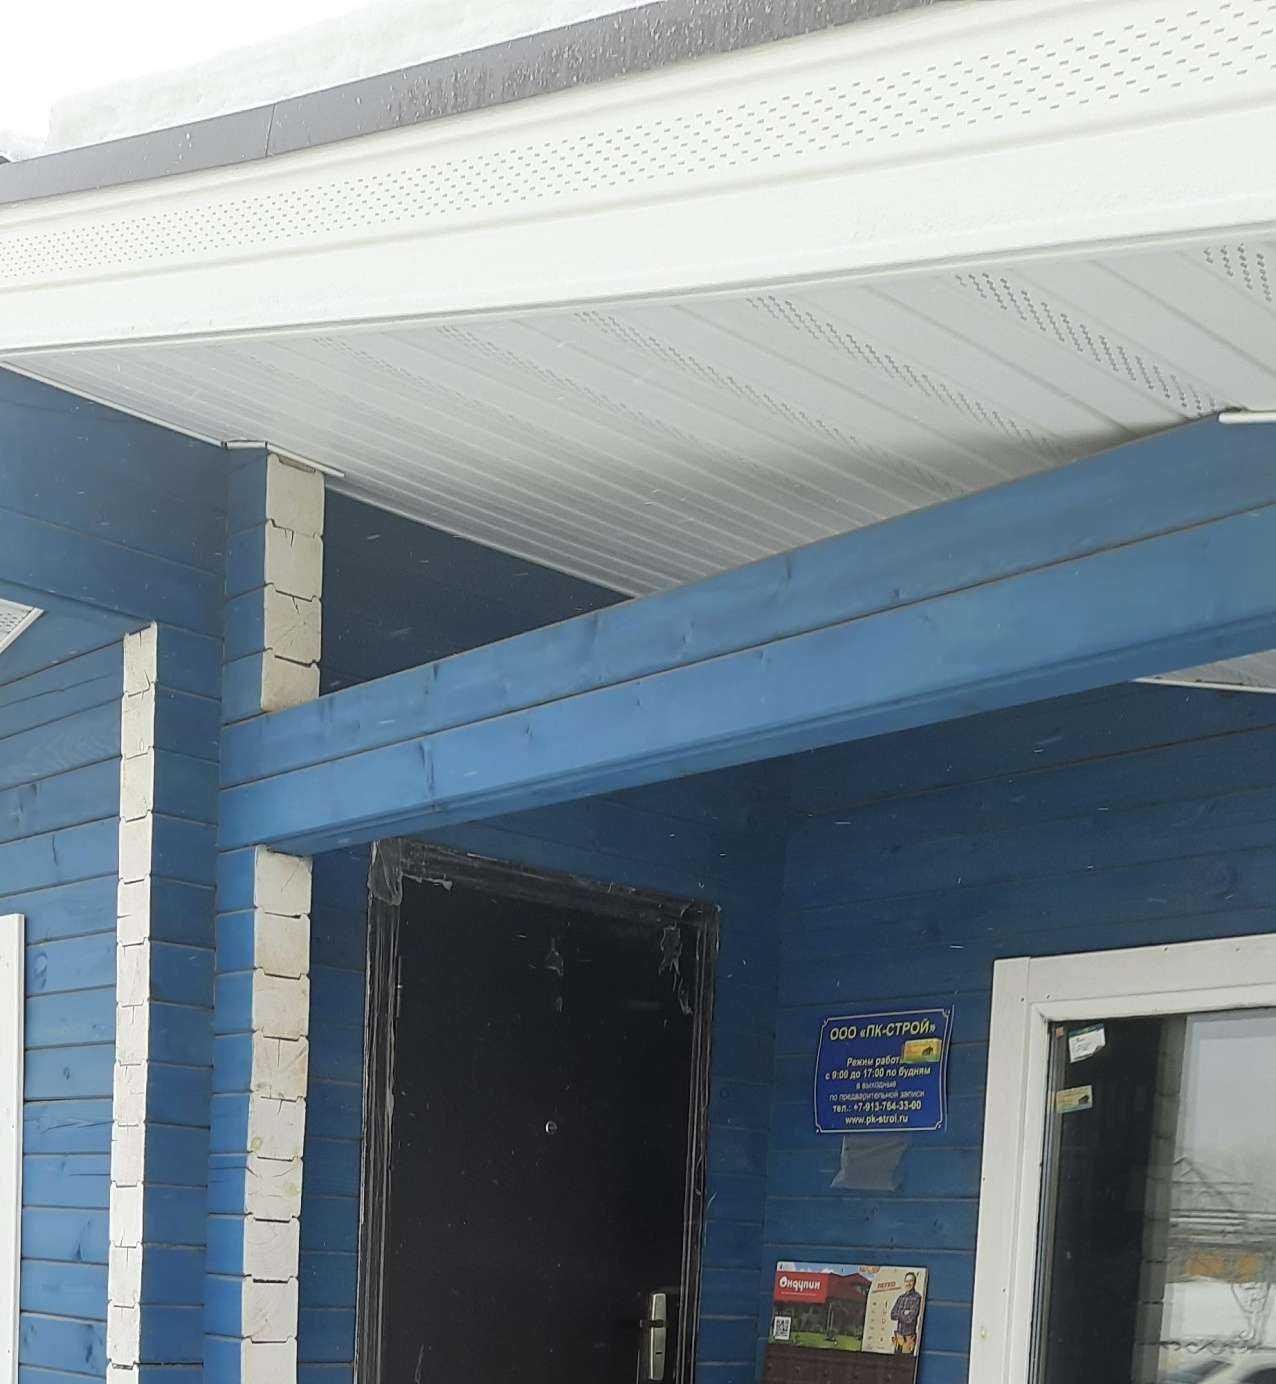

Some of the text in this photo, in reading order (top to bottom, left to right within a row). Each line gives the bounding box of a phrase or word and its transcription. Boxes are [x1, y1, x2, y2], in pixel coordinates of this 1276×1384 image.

[830, 1019, 935, 1041] ООО «ПК-СТРОЙ»
[847, 1057, 874, 1067] Режим
[832, 1070, 848, 1080] 9:00
[849, 1071, 860, 1080] до
[863, 1068, 884, 1078] 17:00
[885, 1069, 897, 1077] по
[898, 1066, 931, 1078] будням
[832, 1105, 851, 1113] тел.:
